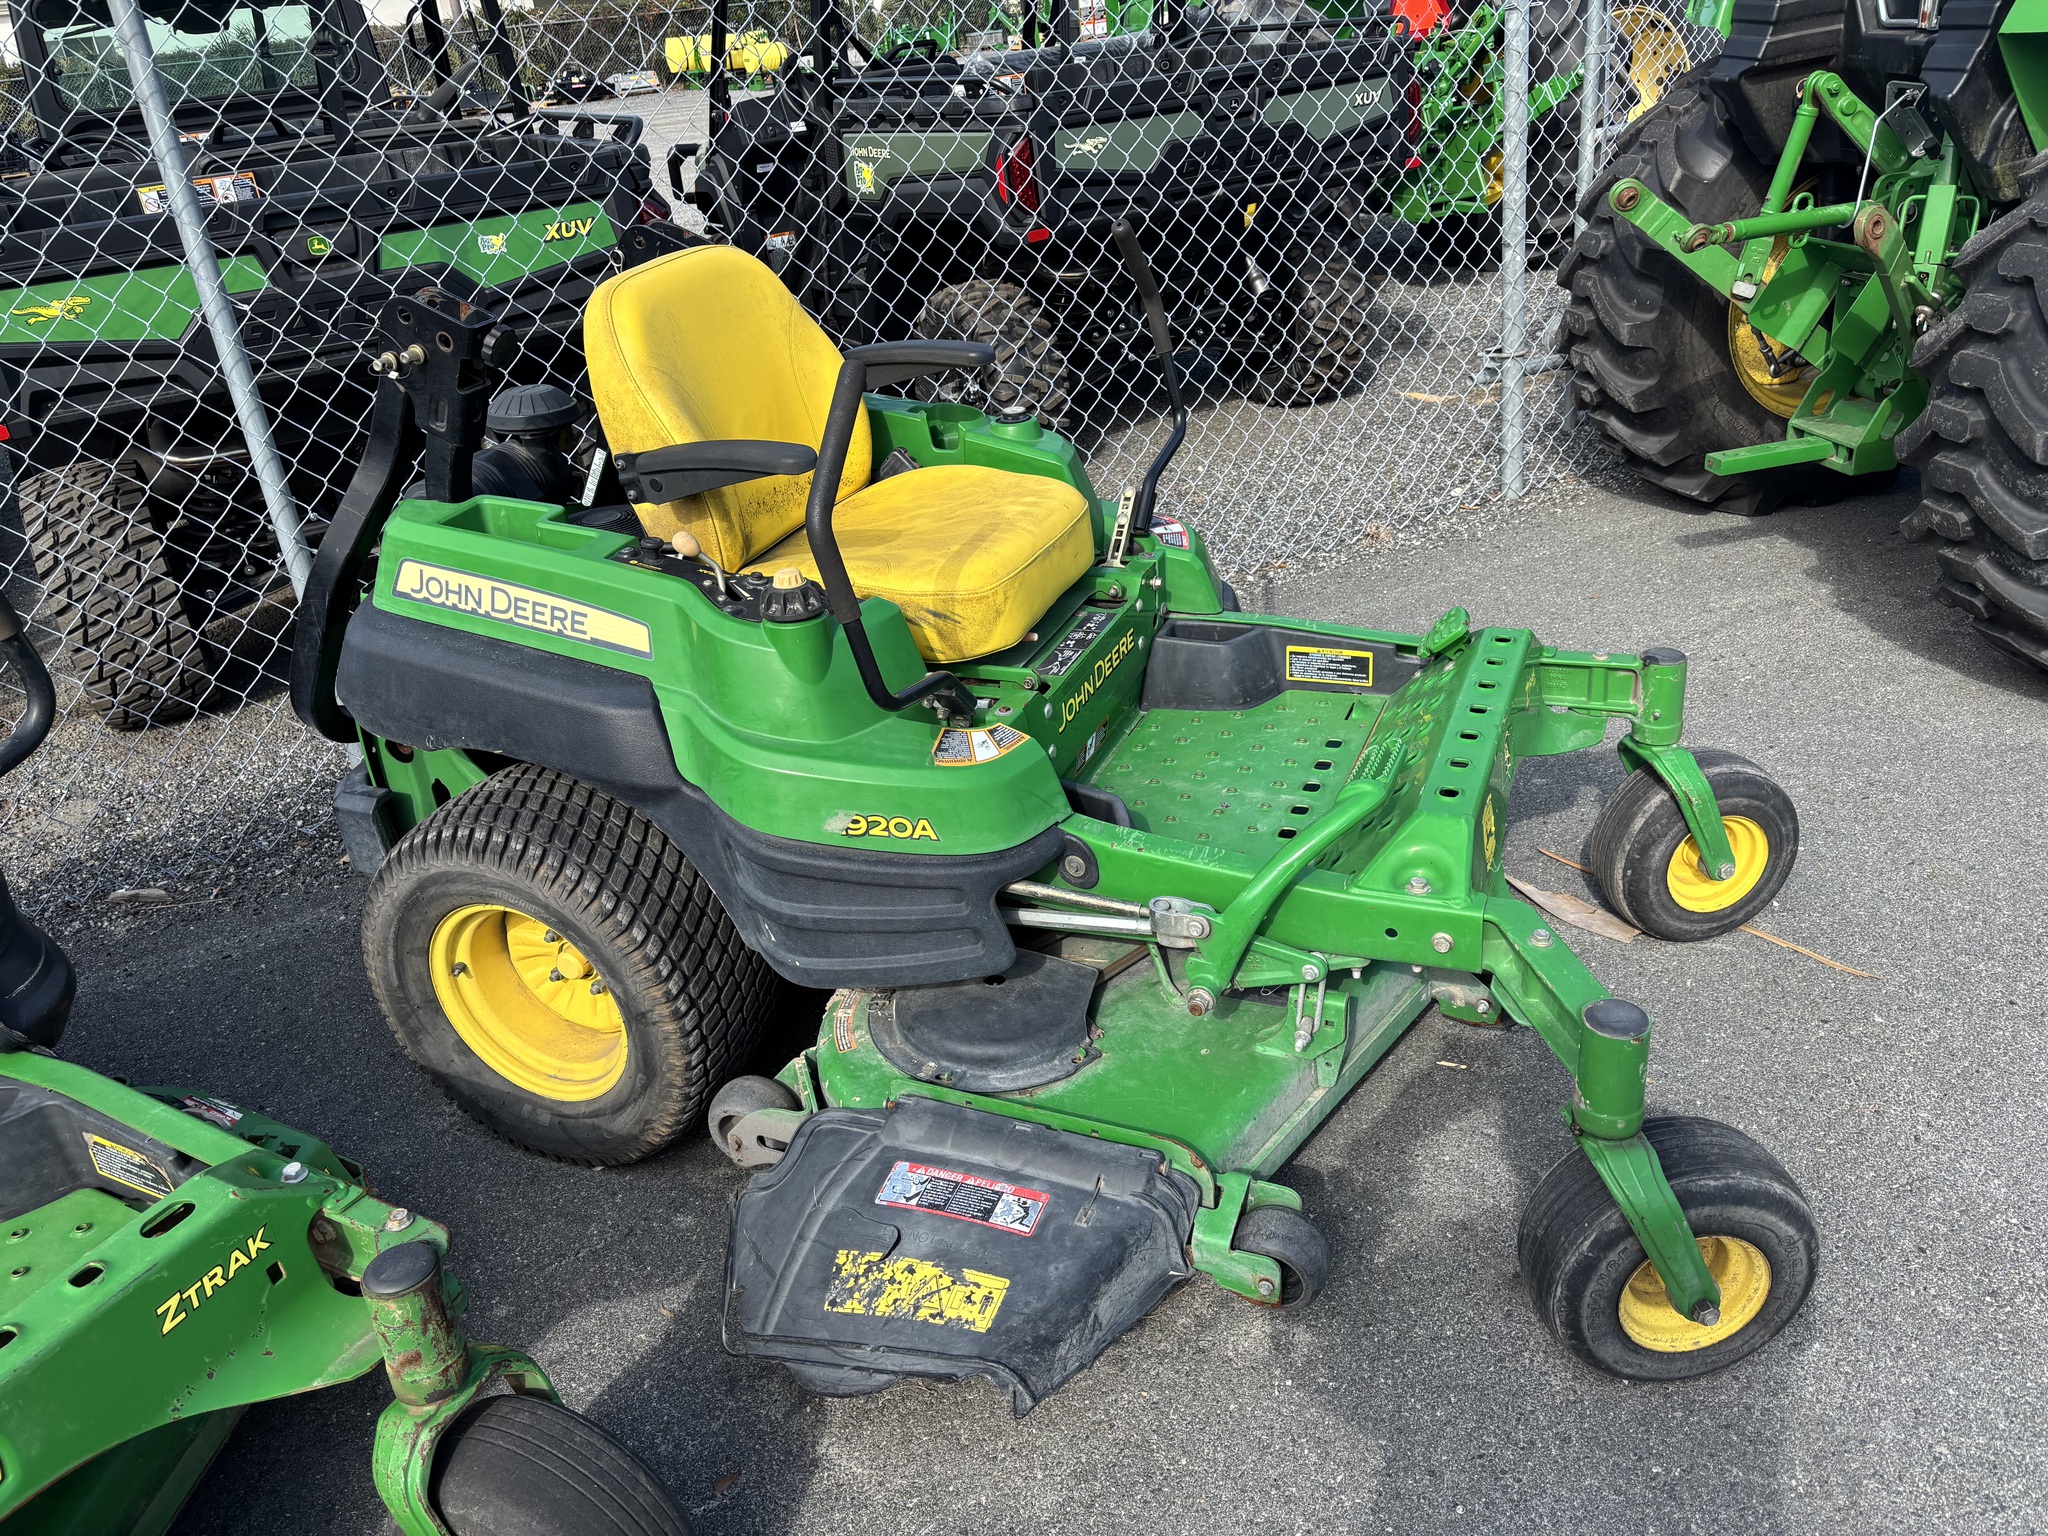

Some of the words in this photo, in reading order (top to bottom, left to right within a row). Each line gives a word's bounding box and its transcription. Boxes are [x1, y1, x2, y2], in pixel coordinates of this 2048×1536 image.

[1353, 89, 1383, 108] XUV
[868, 146, 891, 158] DEERE
[544, 218, 594, 242] XUV
[410, 568, 482, 611] JOHN
[490, 585, 589, 636] DEERE
[1059, 675, 1095, 734] JOHN
[1094, 627, 1136, 689] DEERE
[841, 814, 940, 841] 920A
[926, 1168, 963, 1182] DANGER
[908, 1230, 938, 1244] NOT
[155, 1222, 275, 1337] ZTRAK
[1771, 1234, 1802, 1328] CARLISLE
